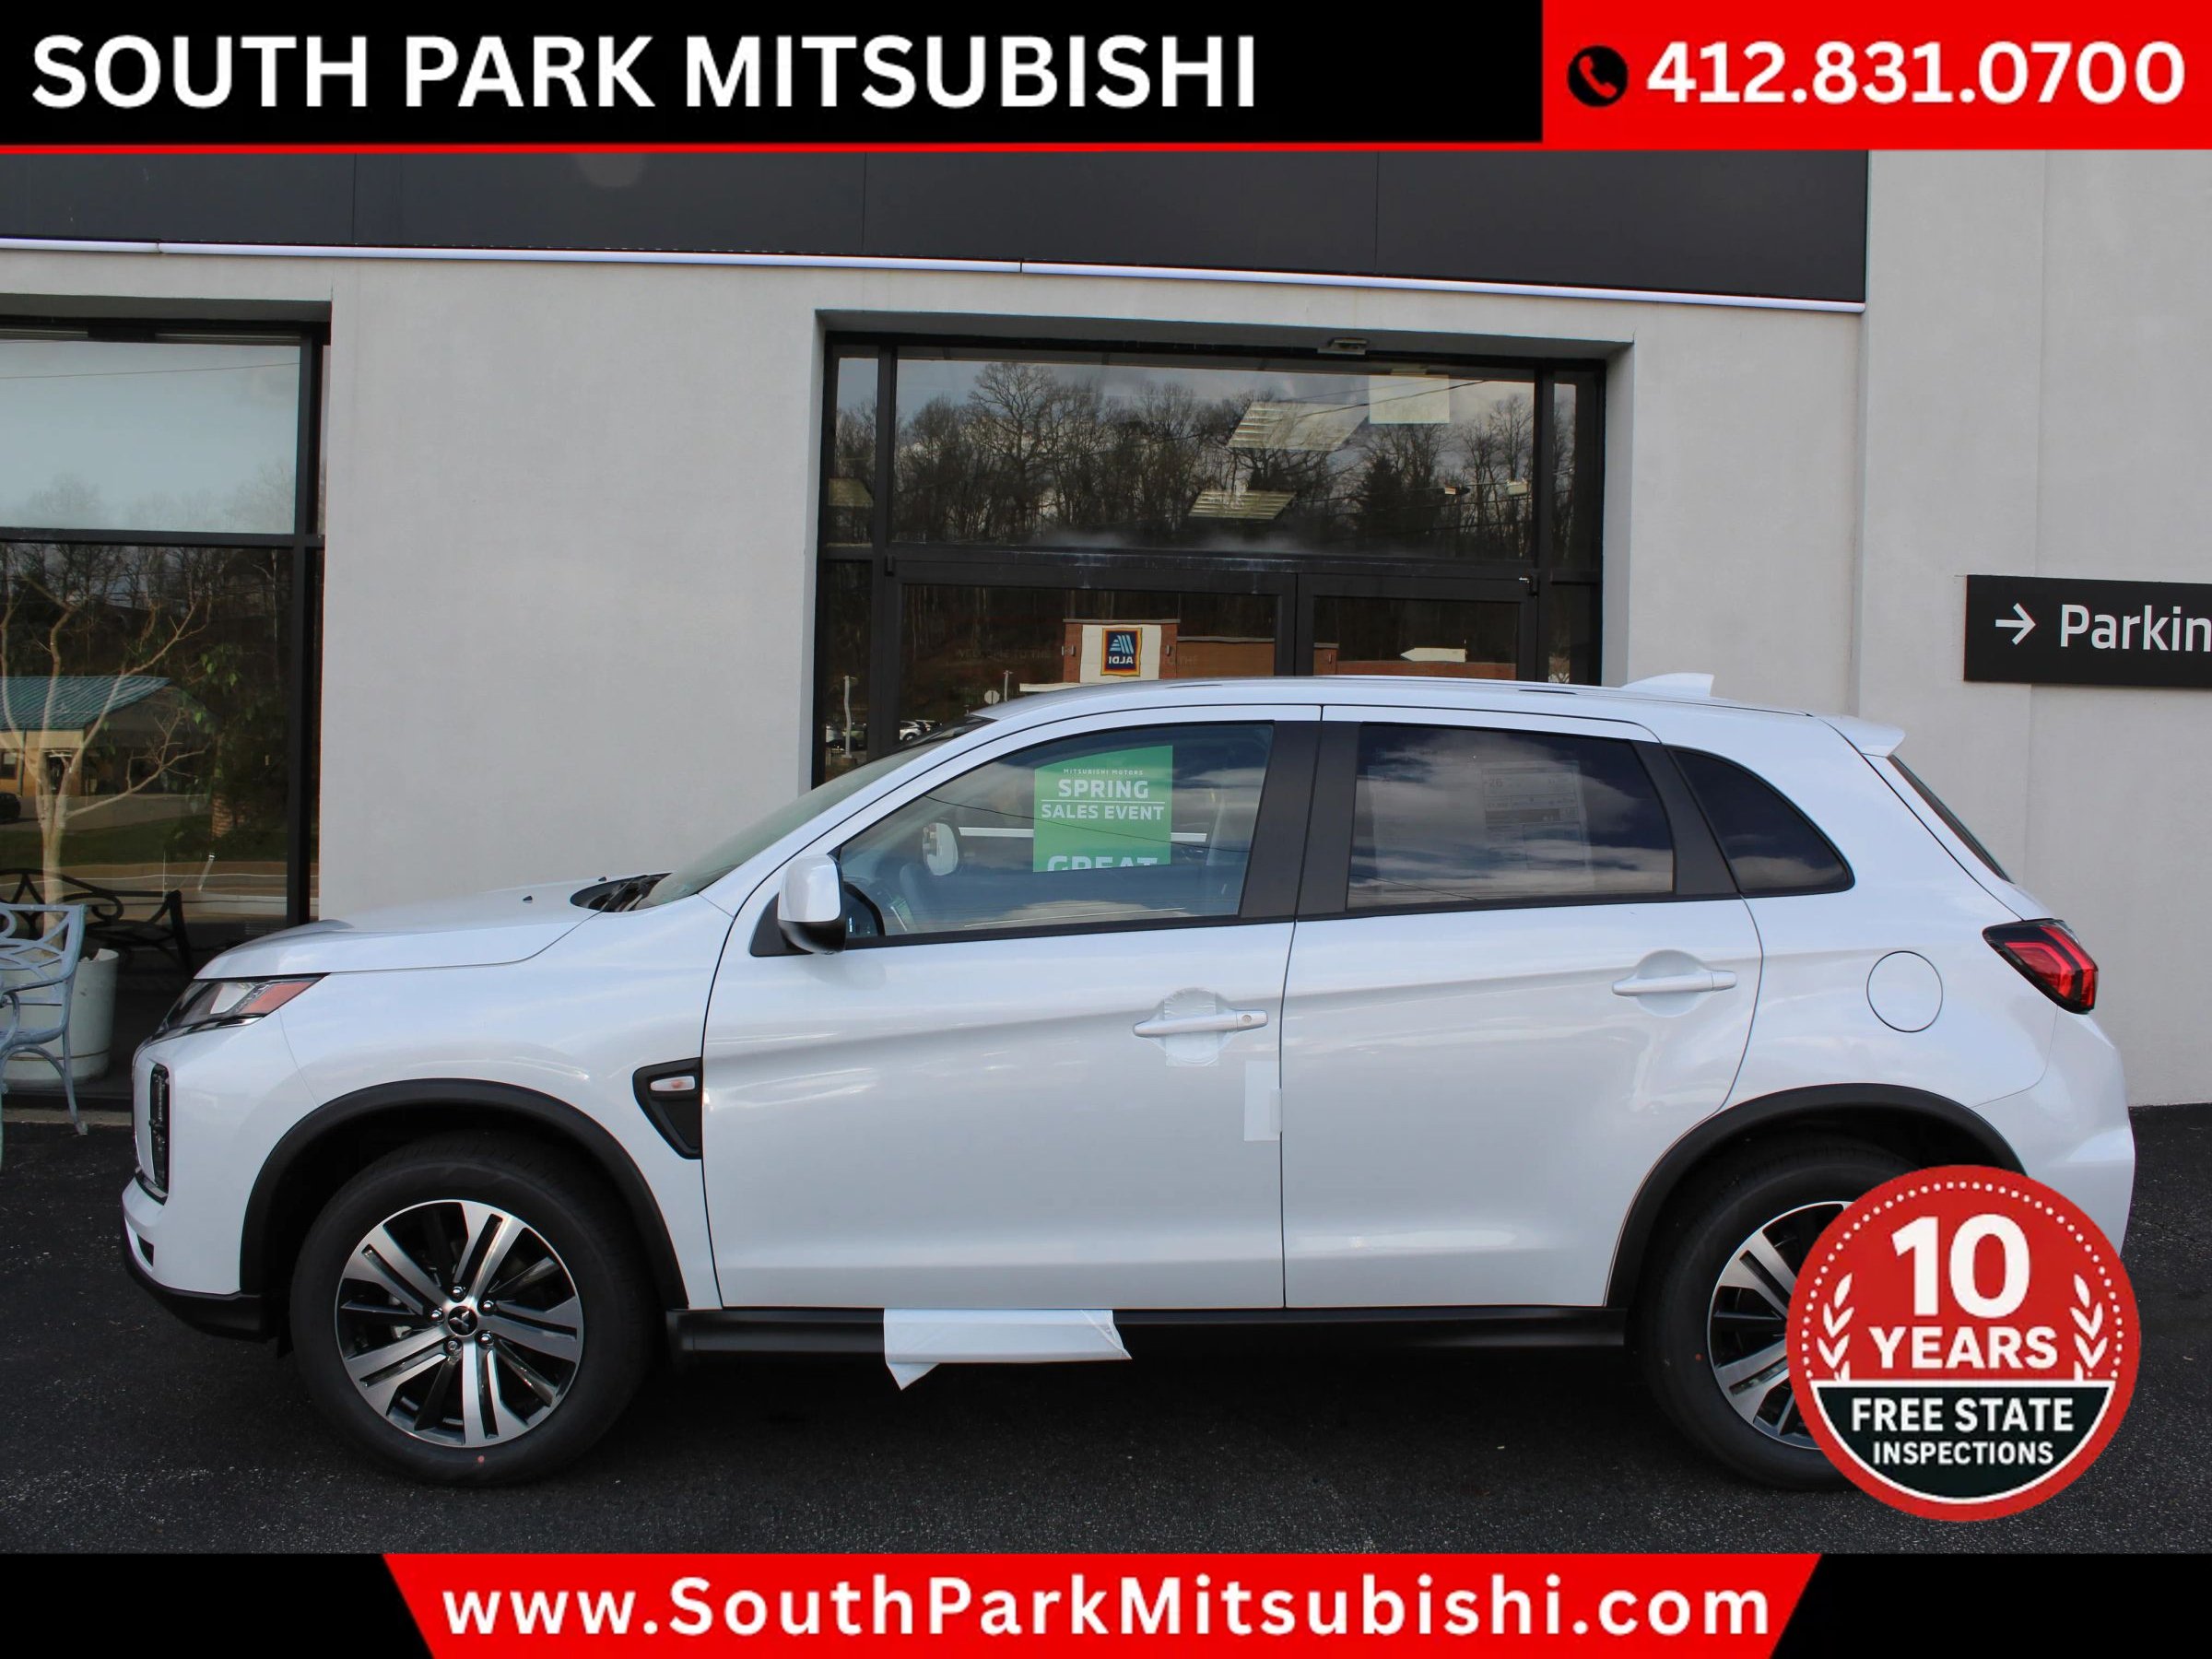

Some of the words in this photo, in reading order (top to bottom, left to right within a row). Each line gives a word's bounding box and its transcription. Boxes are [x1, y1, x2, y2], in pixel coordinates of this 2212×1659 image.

[2060, 604, 2212, 653] Parkin
[1058, 779, 1148, 799] SPRING
[1041, 804, 1099, 819] SALES
[1104, 805, 1164, 820] EVENT
